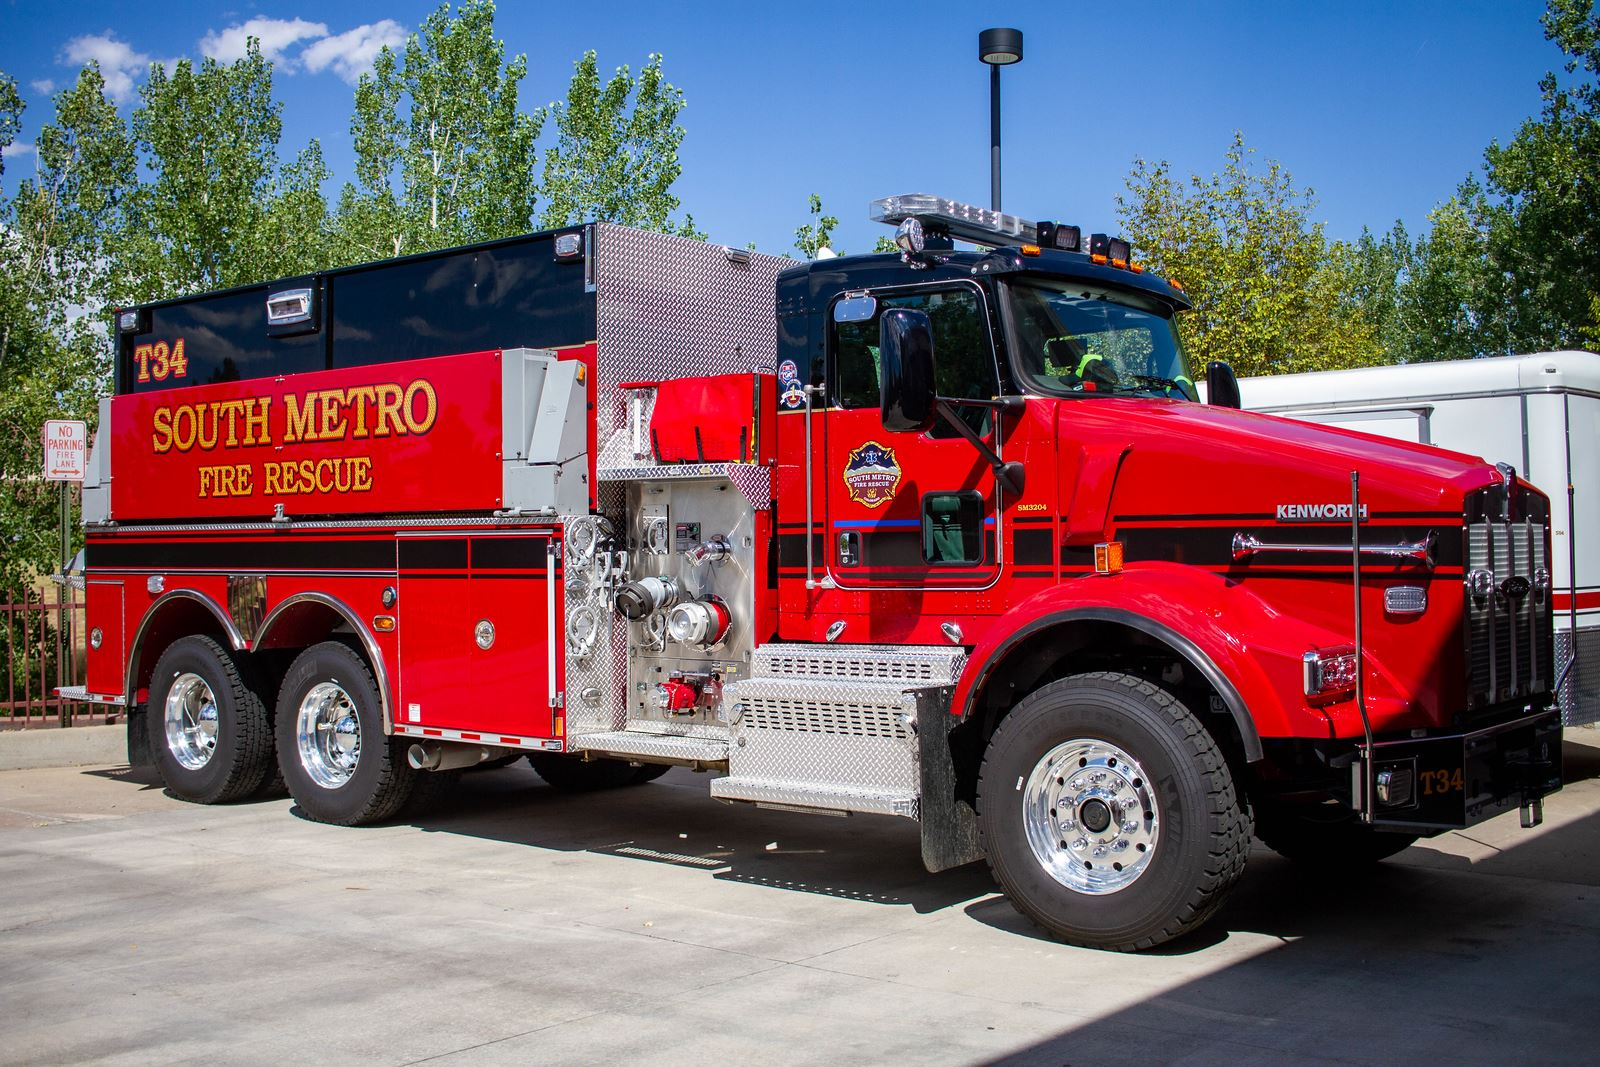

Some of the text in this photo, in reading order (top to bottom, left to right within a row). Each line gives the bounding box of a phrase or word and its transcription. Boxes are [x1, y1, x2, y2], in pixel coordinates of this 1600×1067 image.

[134, 337, 188, 383] T34
[151, 378, 439, 455] SOUTH METRO
[58, 426, 73, 438] NO
[48, 439, 83, 450] PARKING
[56, 451, 76, 460] FIRE
[55, 460, 76, 468] LANE
[198, 456, 374, 498] FIRE RESCUE
[848, 474, 896, 484] SOUTH METRO
[1017, 503, 1047, 511] SM3204
[1276, 503, 1368, 518] KENWORTH
[1420, 767, 1464, 795] T34
